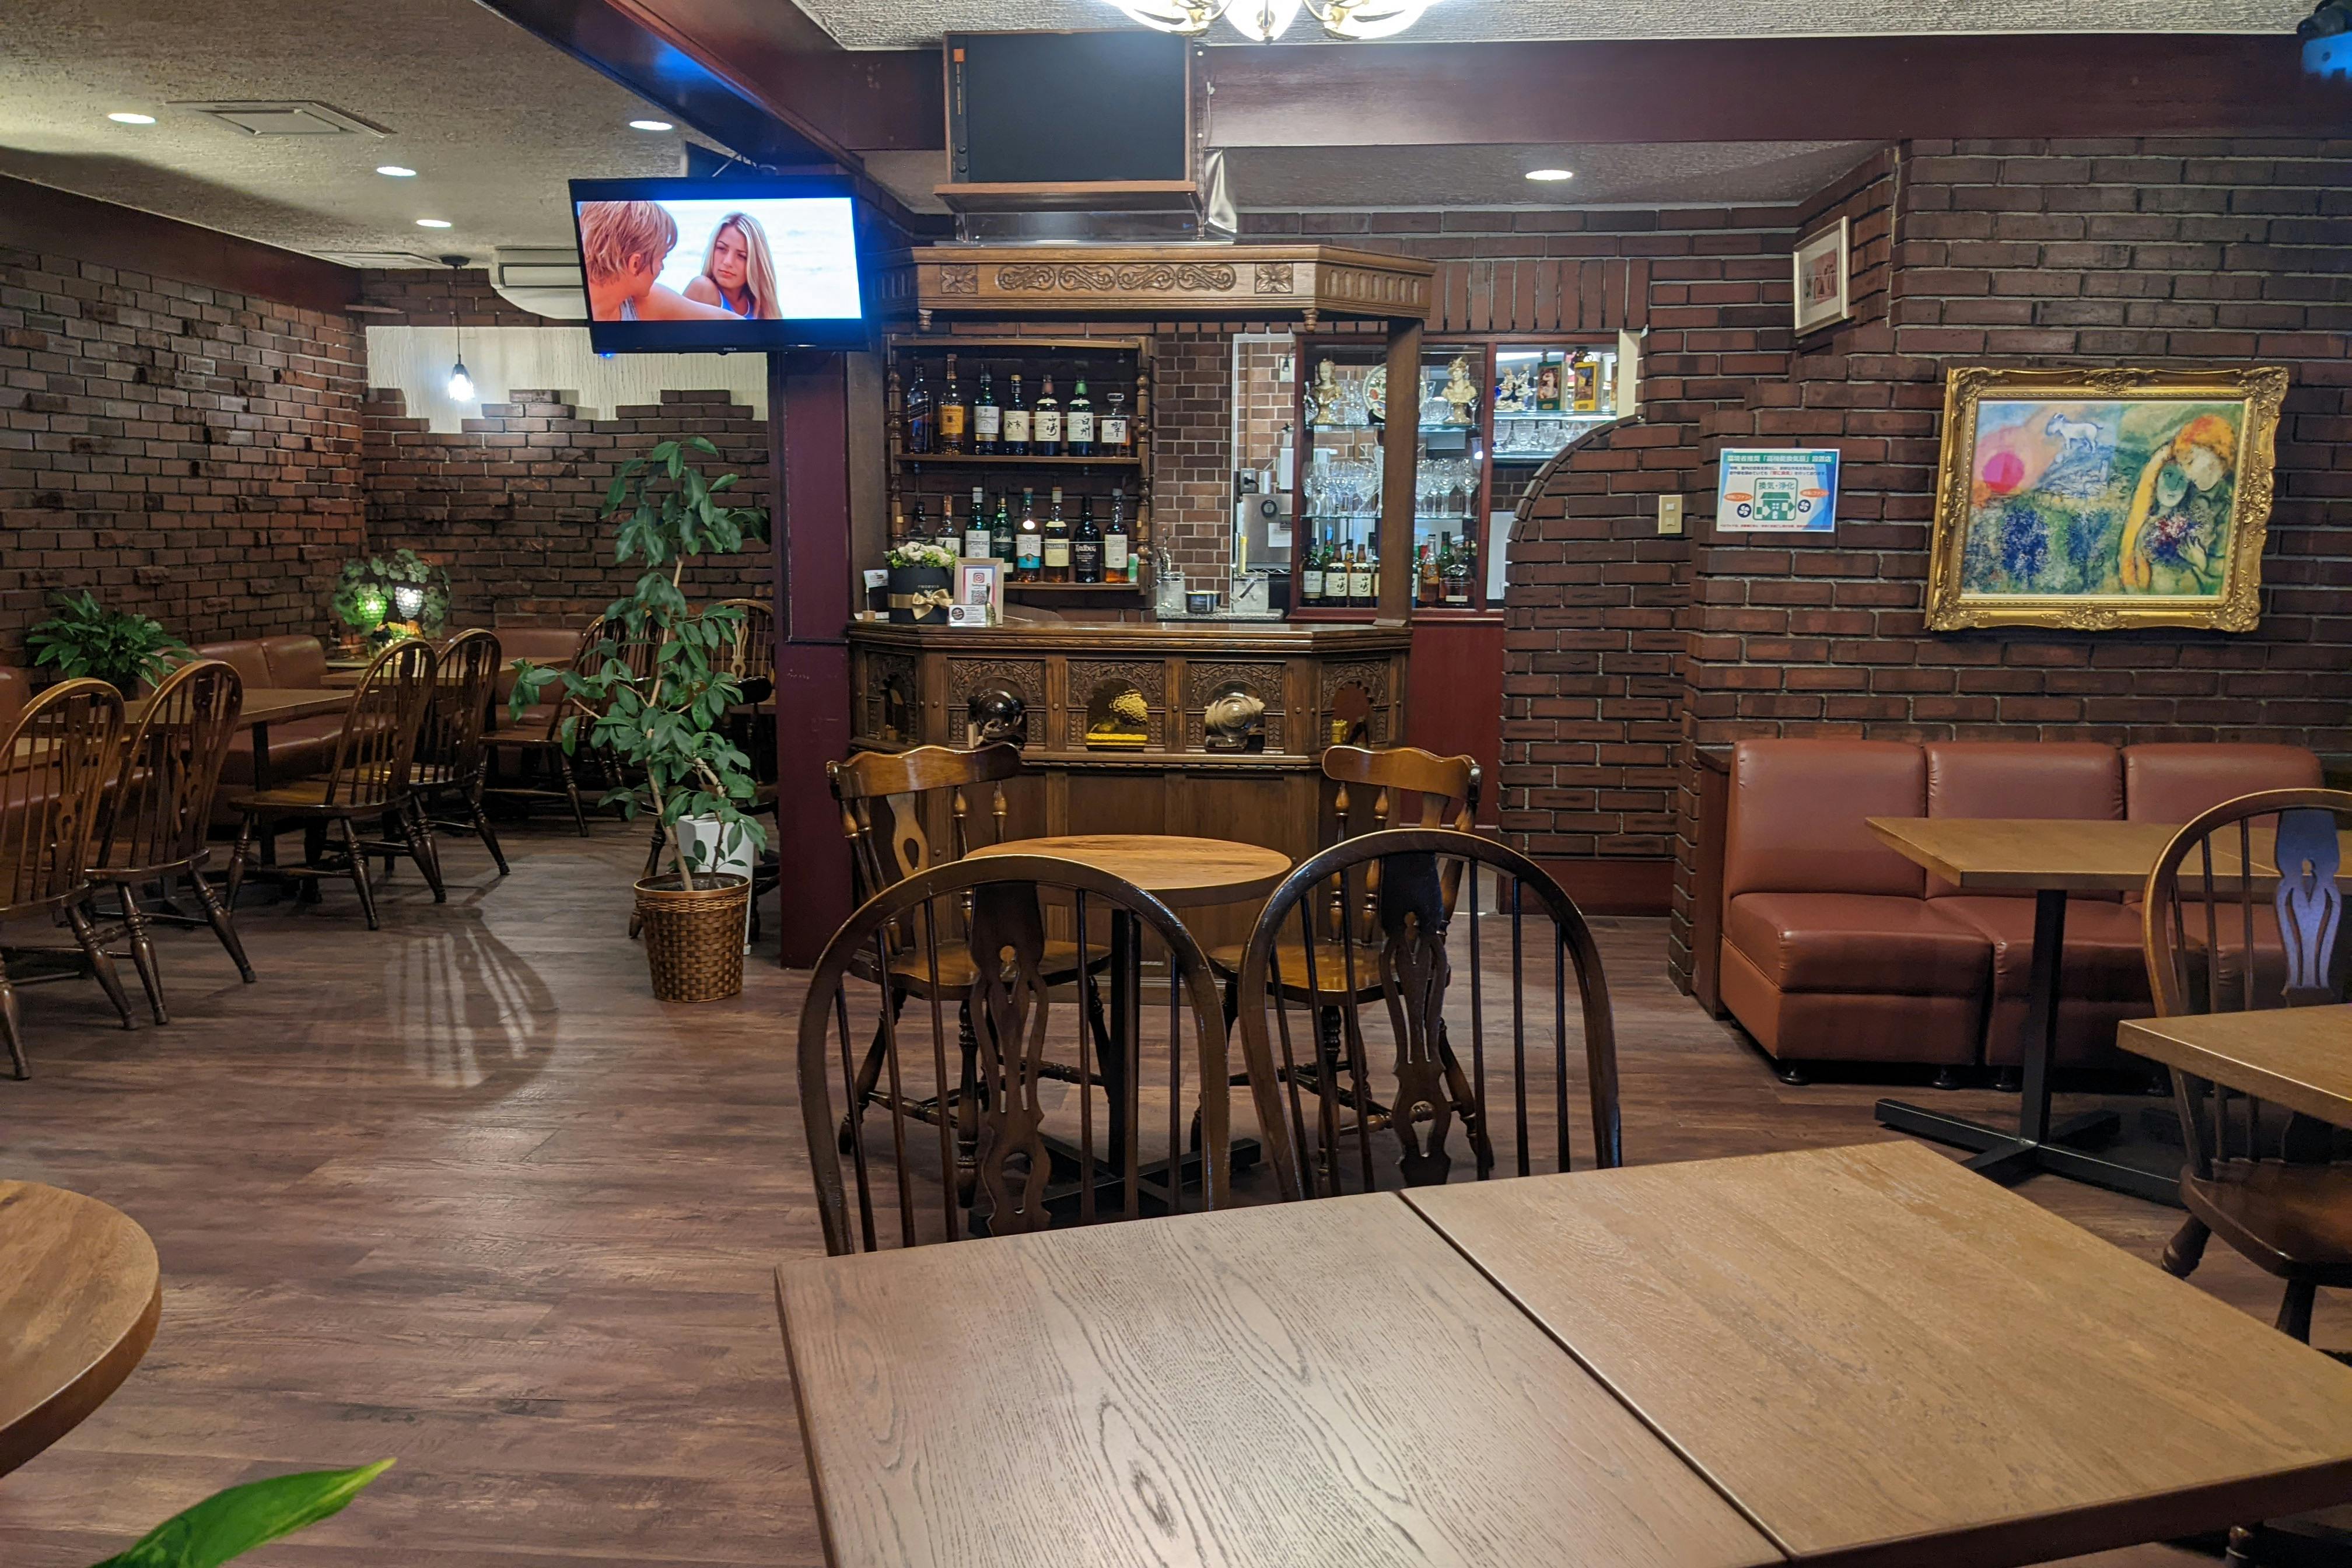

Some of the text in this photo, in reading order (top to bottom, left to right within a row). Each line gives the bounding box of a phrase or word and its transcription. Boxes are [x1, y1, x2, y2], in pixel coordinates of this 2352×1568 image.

[1758, 482, 1795, 490] 換気・浄化
